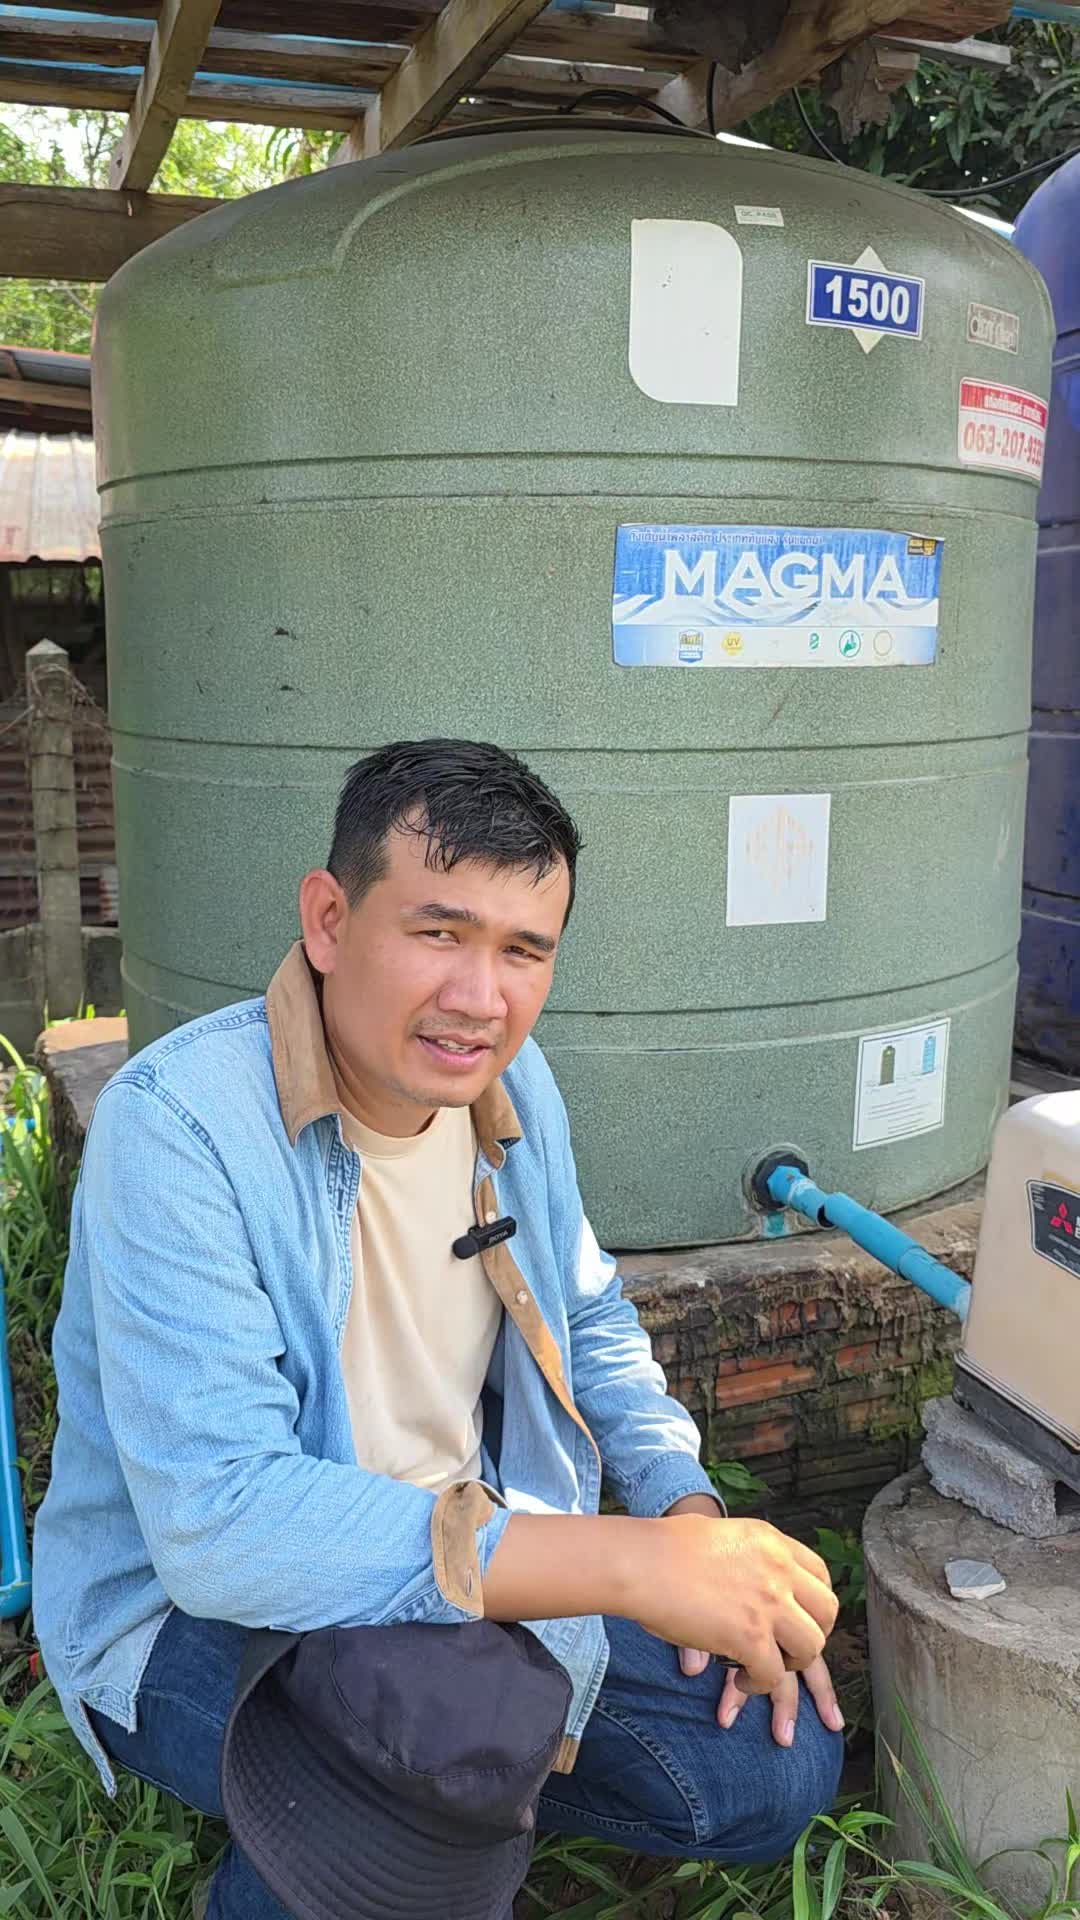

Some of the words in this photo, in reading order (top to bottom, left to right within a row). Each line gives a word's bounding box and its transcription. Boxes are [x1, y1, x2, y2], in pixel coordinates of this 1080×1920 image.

[825, 274, 910, 325] 1500
[663, 549, 909, 601] MAGMA
[727, 637, 741, 647] UV
